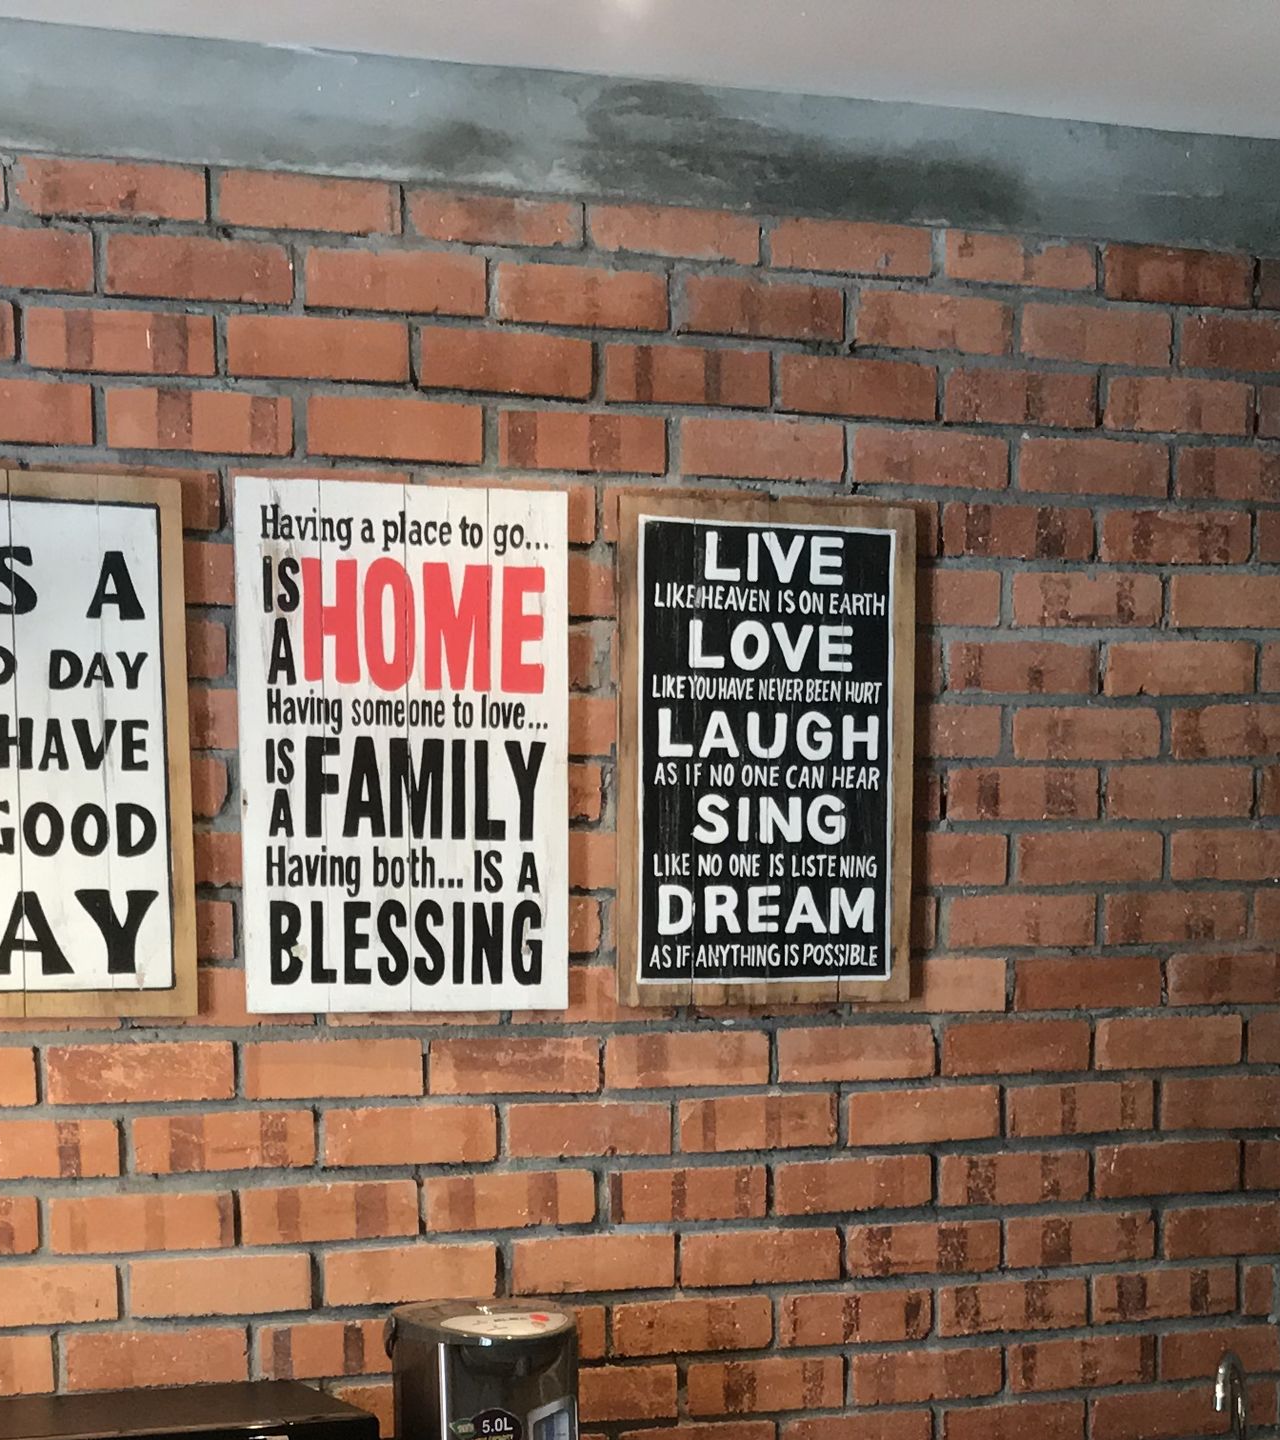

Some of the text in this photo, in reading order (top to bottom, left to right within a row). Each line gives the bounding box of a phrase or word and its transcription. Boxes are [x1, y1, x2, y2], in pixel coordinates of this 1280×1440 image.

[260, 504, 549, 555] Having a place to go...
[704, 531, 844, 585] LIVE
[86, 551, 145, 620] A
[262, 555, 300, 613] IS
[654, 582, 885, 616] LIKE HEAVEN IS ON EARTH
[301, 557, 545, 693] HOME
[688, 619, 853, 672] LOVE
[49, 650, 148, 689] DAY
[268, 617, 297, 685] A
[267, 688, 548, 734] Having someone to love...
[652, 674, 882, 704] LIKE YOU HAVE NEVER BEEN HURT
[657, 707, 880, 761] LAUGH
[265, 738, 294, 784] IS
[654, 763, 880, 791] AS IF NO ONE CAN HEAR
[269, 788, 294, 837] A
[305, 736, 547, 841] FAMILY
[692, 794, 846, 845] SING
[266, 845, 540, 897] Having both... IS A
[653, 854, 877, 878] LIKE NO ONE IS LISTENING
[657, 884, 875, 935] DREAM
[270, 899, 543, 986] BLESSING
[649, 943, 878, 970] AS IF ANYTHING IS POSSIBLE
[482, 1417, 514, 1433] 5.0L
